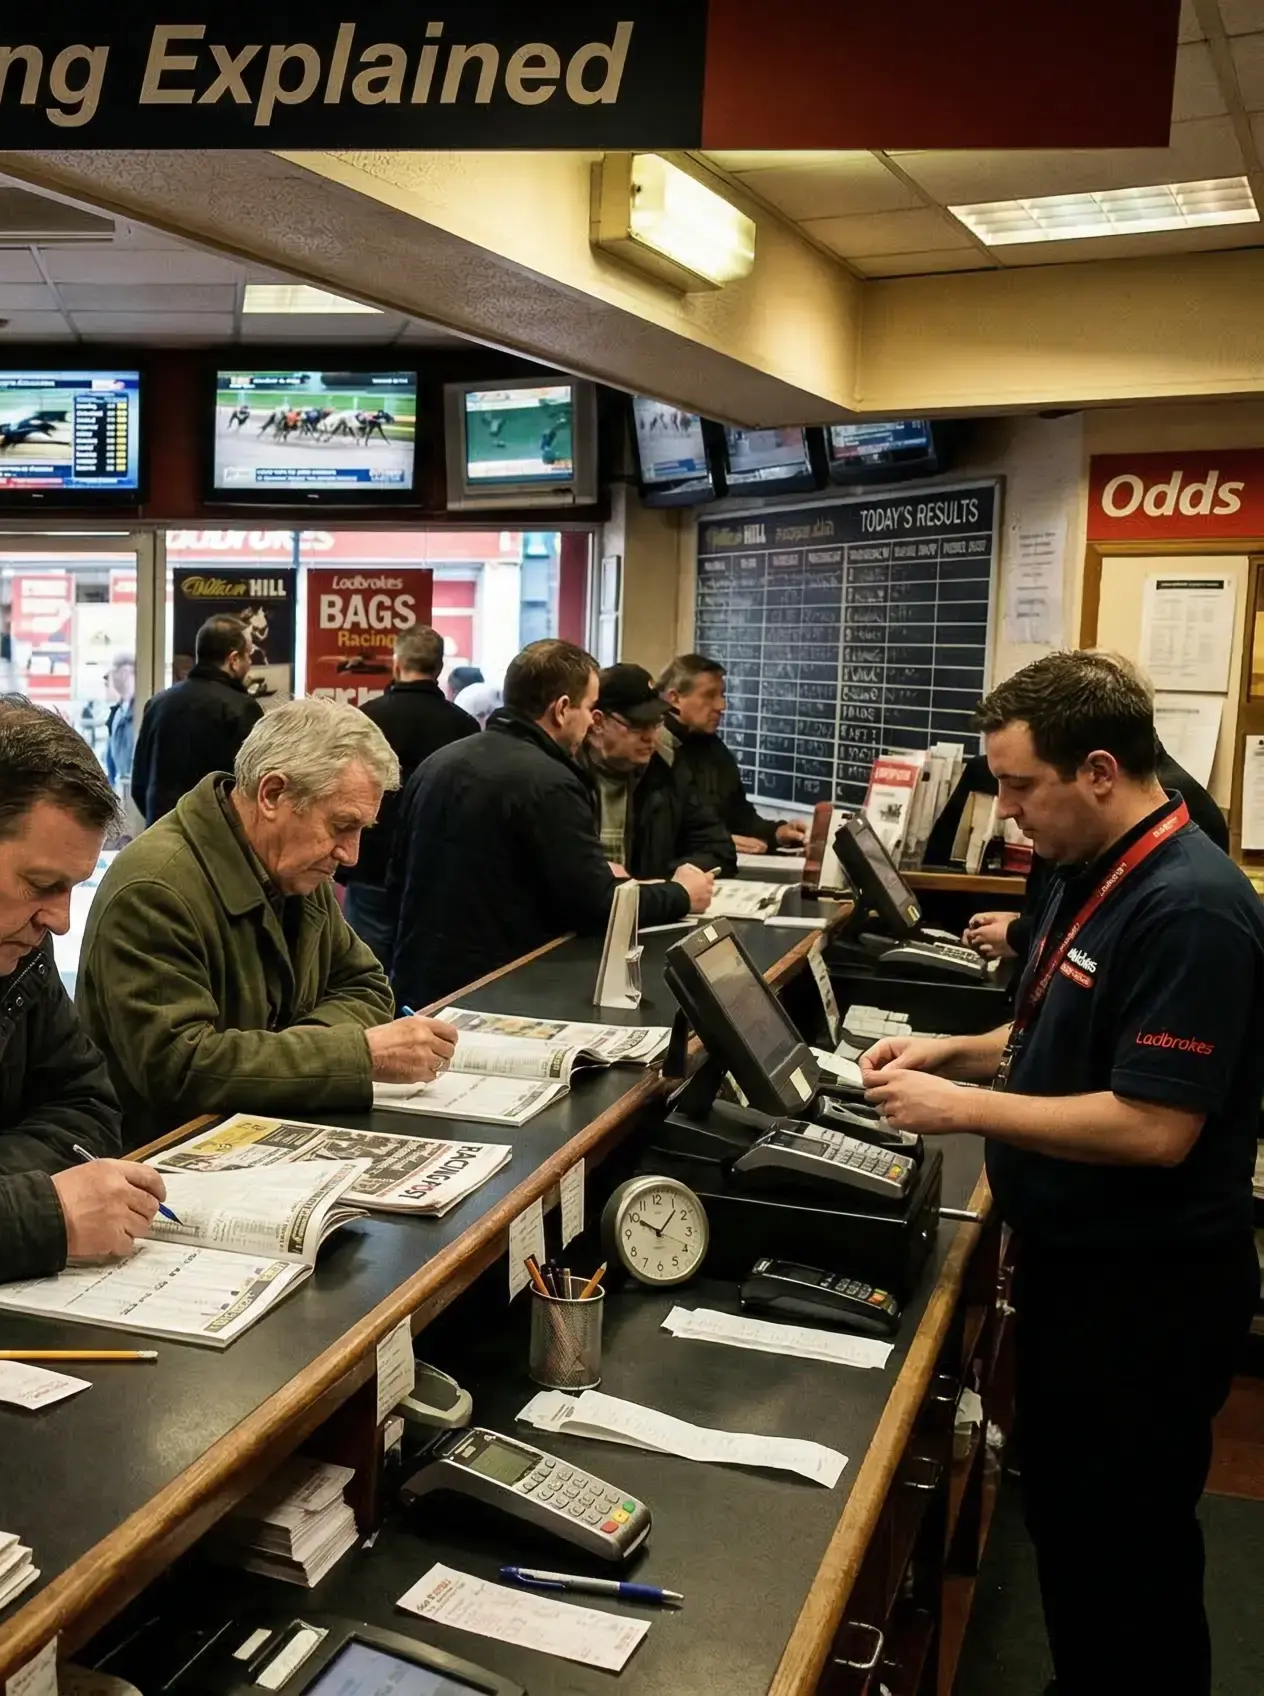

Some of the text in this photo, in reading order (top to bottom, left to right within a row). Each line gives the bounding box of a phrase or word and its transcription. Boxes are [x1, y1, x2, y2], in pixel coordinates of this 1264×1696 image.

[138, 20, 635, 127] Explained
[1101, 470, 1246, 518] Odds
[859, 504, 913, 533] TODAY'S
[916, 499, 979, 526] RESULTS
[250, 578, 287, 597] HILL
[319, 594, 416, 631] BAGS
[338, 630, 398, 649] Racing
[1135, 1030, 1216, 1056] Ladbrokes
[420, 1145, 484, 1182] RACING
[639, 1200, 646, 1211] 11
[652, 1194, 662, 1206] 12
[628, 1212, 641, 1223] 10
[680, 1209, 687, 1221] 2
[624, 1228, 632, 1240] 9
[685, 1226, 693, 1237] 3
[630, 1246, 638, 1257] 8
[682, 1243, 688, 1252] 4
[642, 1257, 649, 1269] 7
[657, 1260, 664, 1272] 6
[672, 1255, 679, 1267] 5
